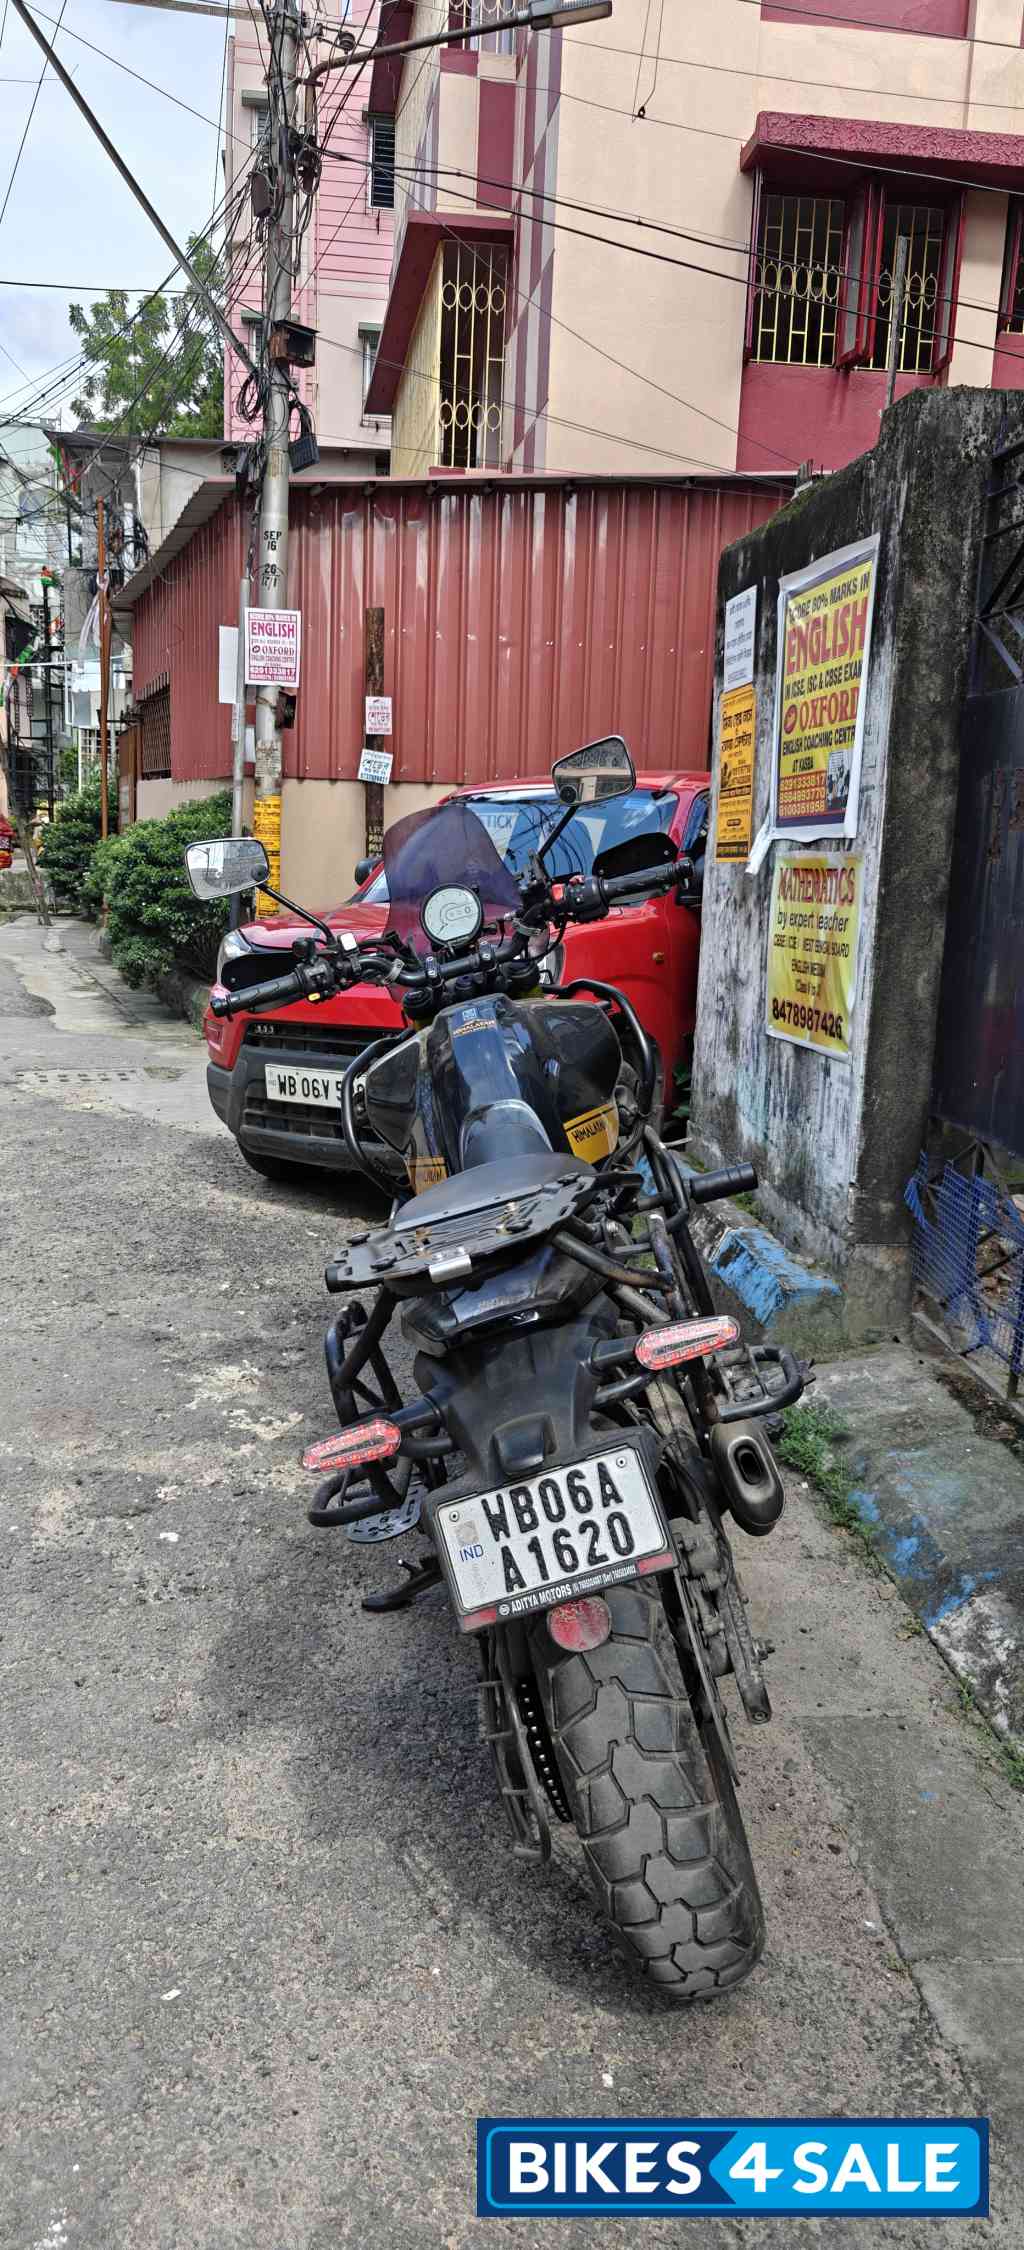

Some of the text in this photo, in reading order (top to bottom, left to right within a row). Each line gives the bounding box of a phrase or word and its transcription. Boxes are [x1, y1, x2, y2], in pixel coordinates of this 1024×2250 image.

[263, 530, 282, 541] SEP
[829, 577, 858, 605] MARKS
[860, 571, 871, 592] IN
[250, 621, 295, 638] ENGLISH
[786, 596, 868, 676] ENGLISH
[825, 666, 842, 689] CBSE
[803, 729, 833, 752] COACHING
[834, 724, 857, 746] CENTR
[778, 867, 855, 906] MATHEMATICS
[777, 905, 787, 930] by
[789, 912, 815, 931] expert
[772, 998, 843, 1039] 8478987426
[277, 1073, 297, 1096] WB
[481, 1462, 624, 1542] WB06A
[459, 1544, 485, 1562] IND
[500, 1511, 635, 1593] A1620
[510, 1592, 539, 1614] ADITYA
[538, 1583, 573, 1602] MOTORS
